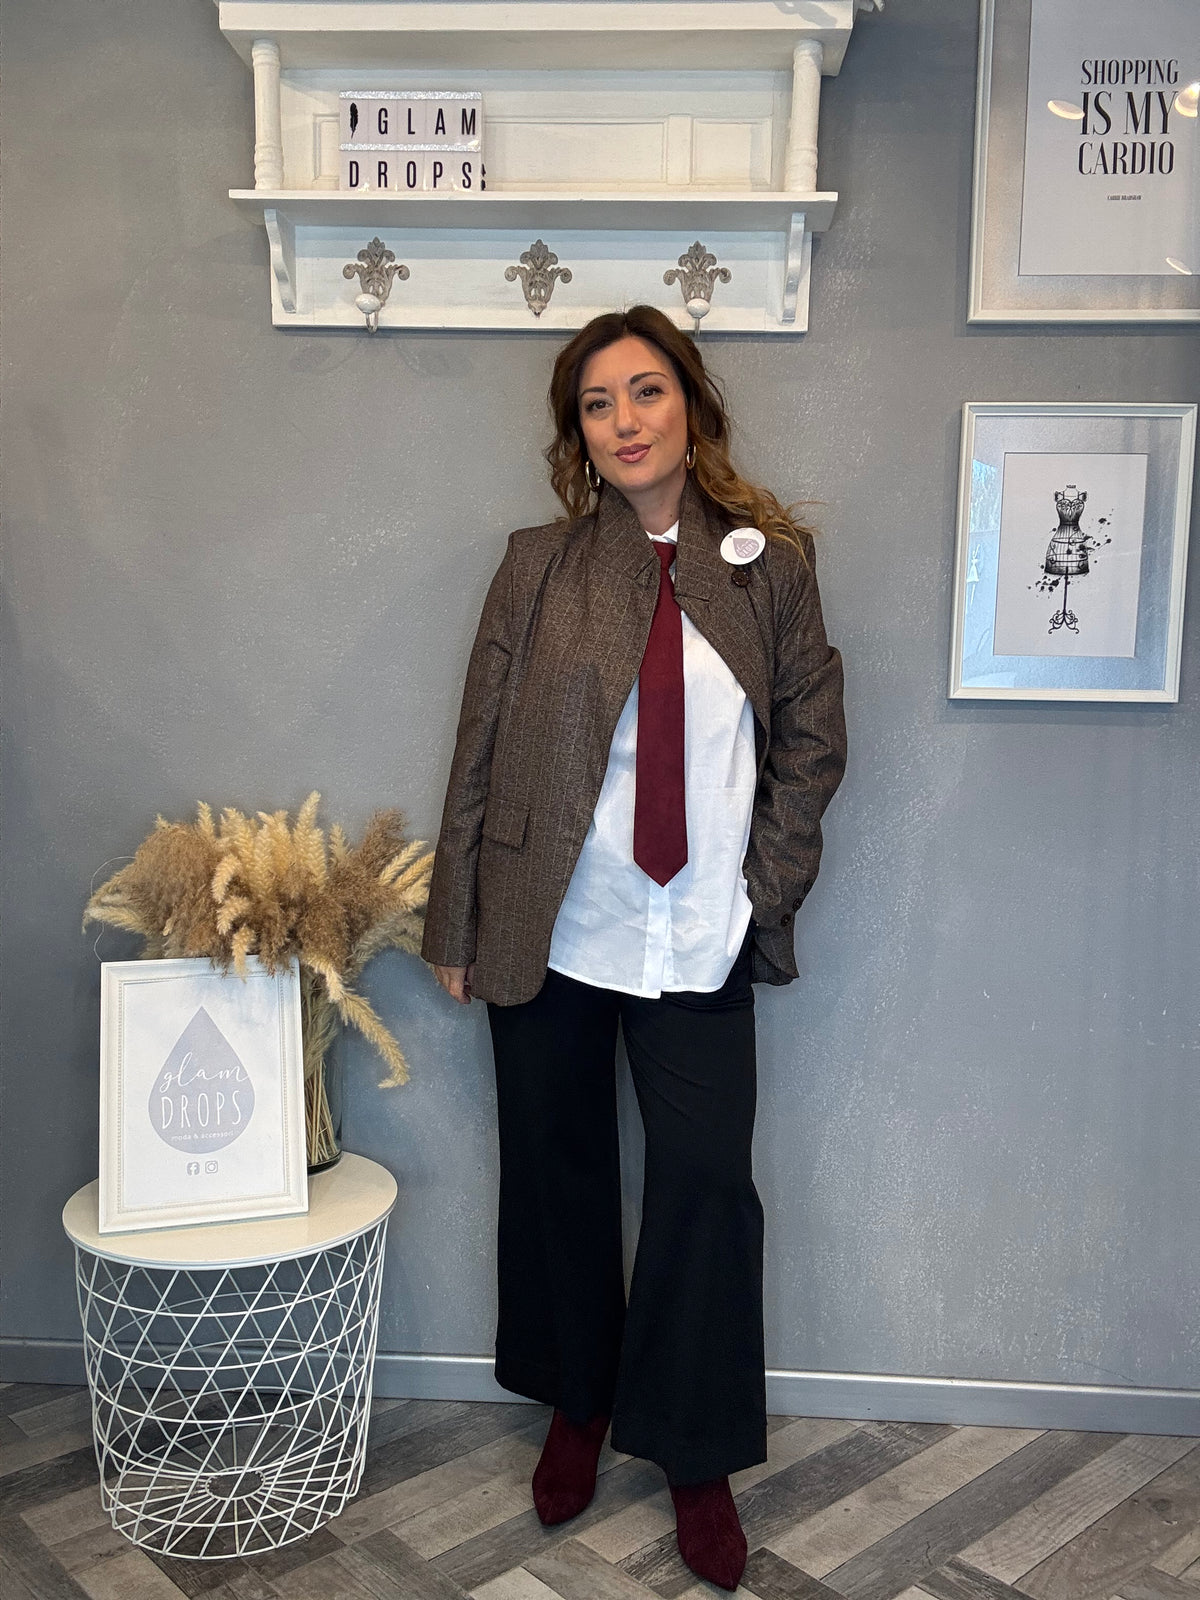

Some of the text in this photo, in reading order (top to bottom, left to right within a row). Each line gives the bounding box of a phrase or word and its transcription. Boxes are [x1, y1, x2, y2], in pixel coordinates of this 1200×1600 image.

[1080, 59, 1179, 85] SHOPPING
[377, 107, 476, 135] GLAM
[1080, 91, 1179, 135] IS MY
[349, 160, 472, 189] DROPS
[1078, 141, 1174, 175] CARDIO
[160, 1052, 249, 1093] glam
[161, 1090, 241, 1130] DROPS
